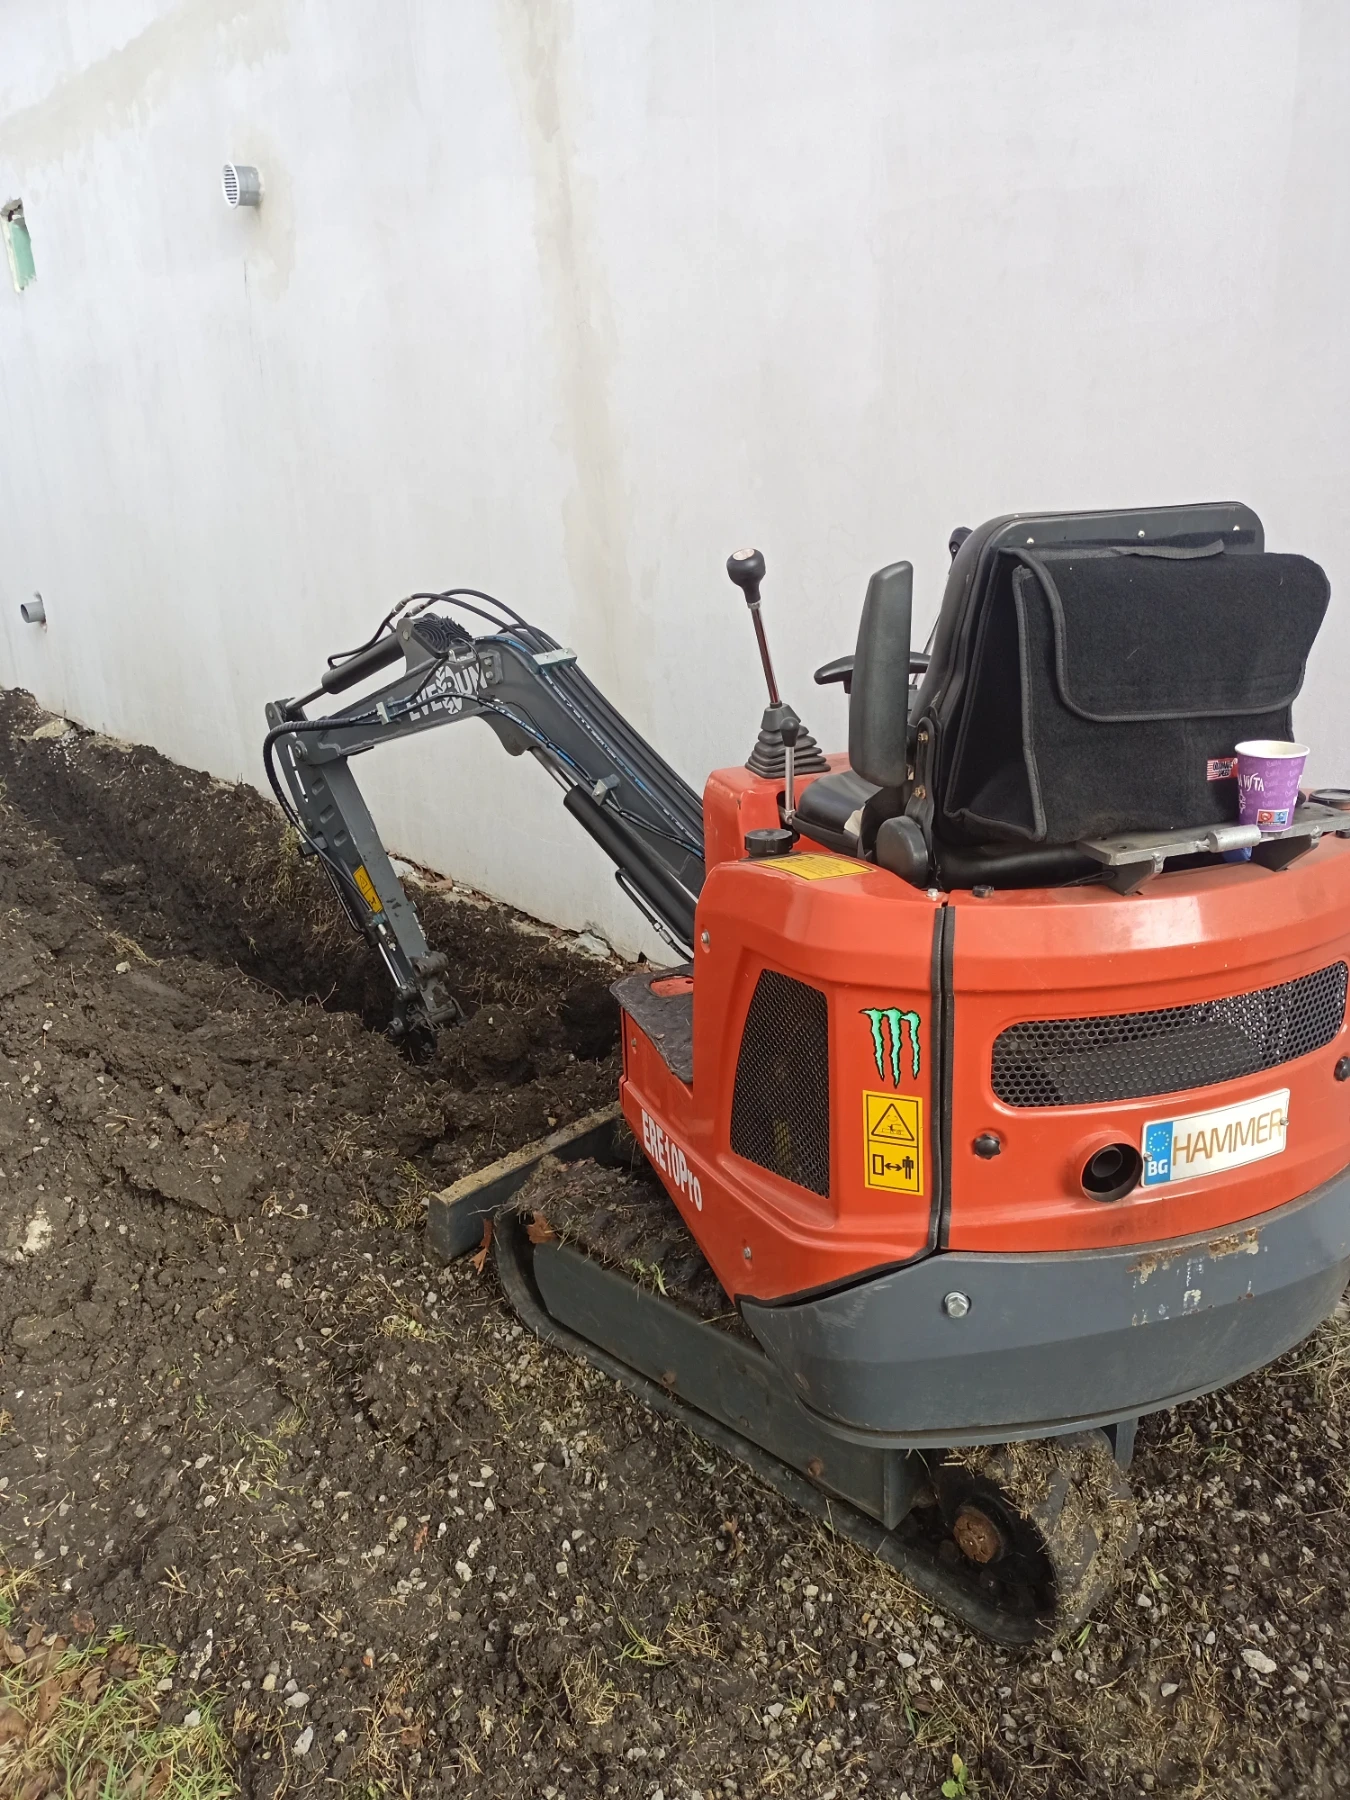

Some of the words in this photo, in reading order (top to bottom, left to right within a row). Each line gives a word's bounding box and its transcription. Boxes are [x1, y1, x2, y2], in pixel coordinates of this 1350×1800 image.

[641, 1108, 703, 1212] ERE10Pro
[1172, 1108, 1283, 1166] HAMMER
[1147, 1159, 1169, 1177] BG
